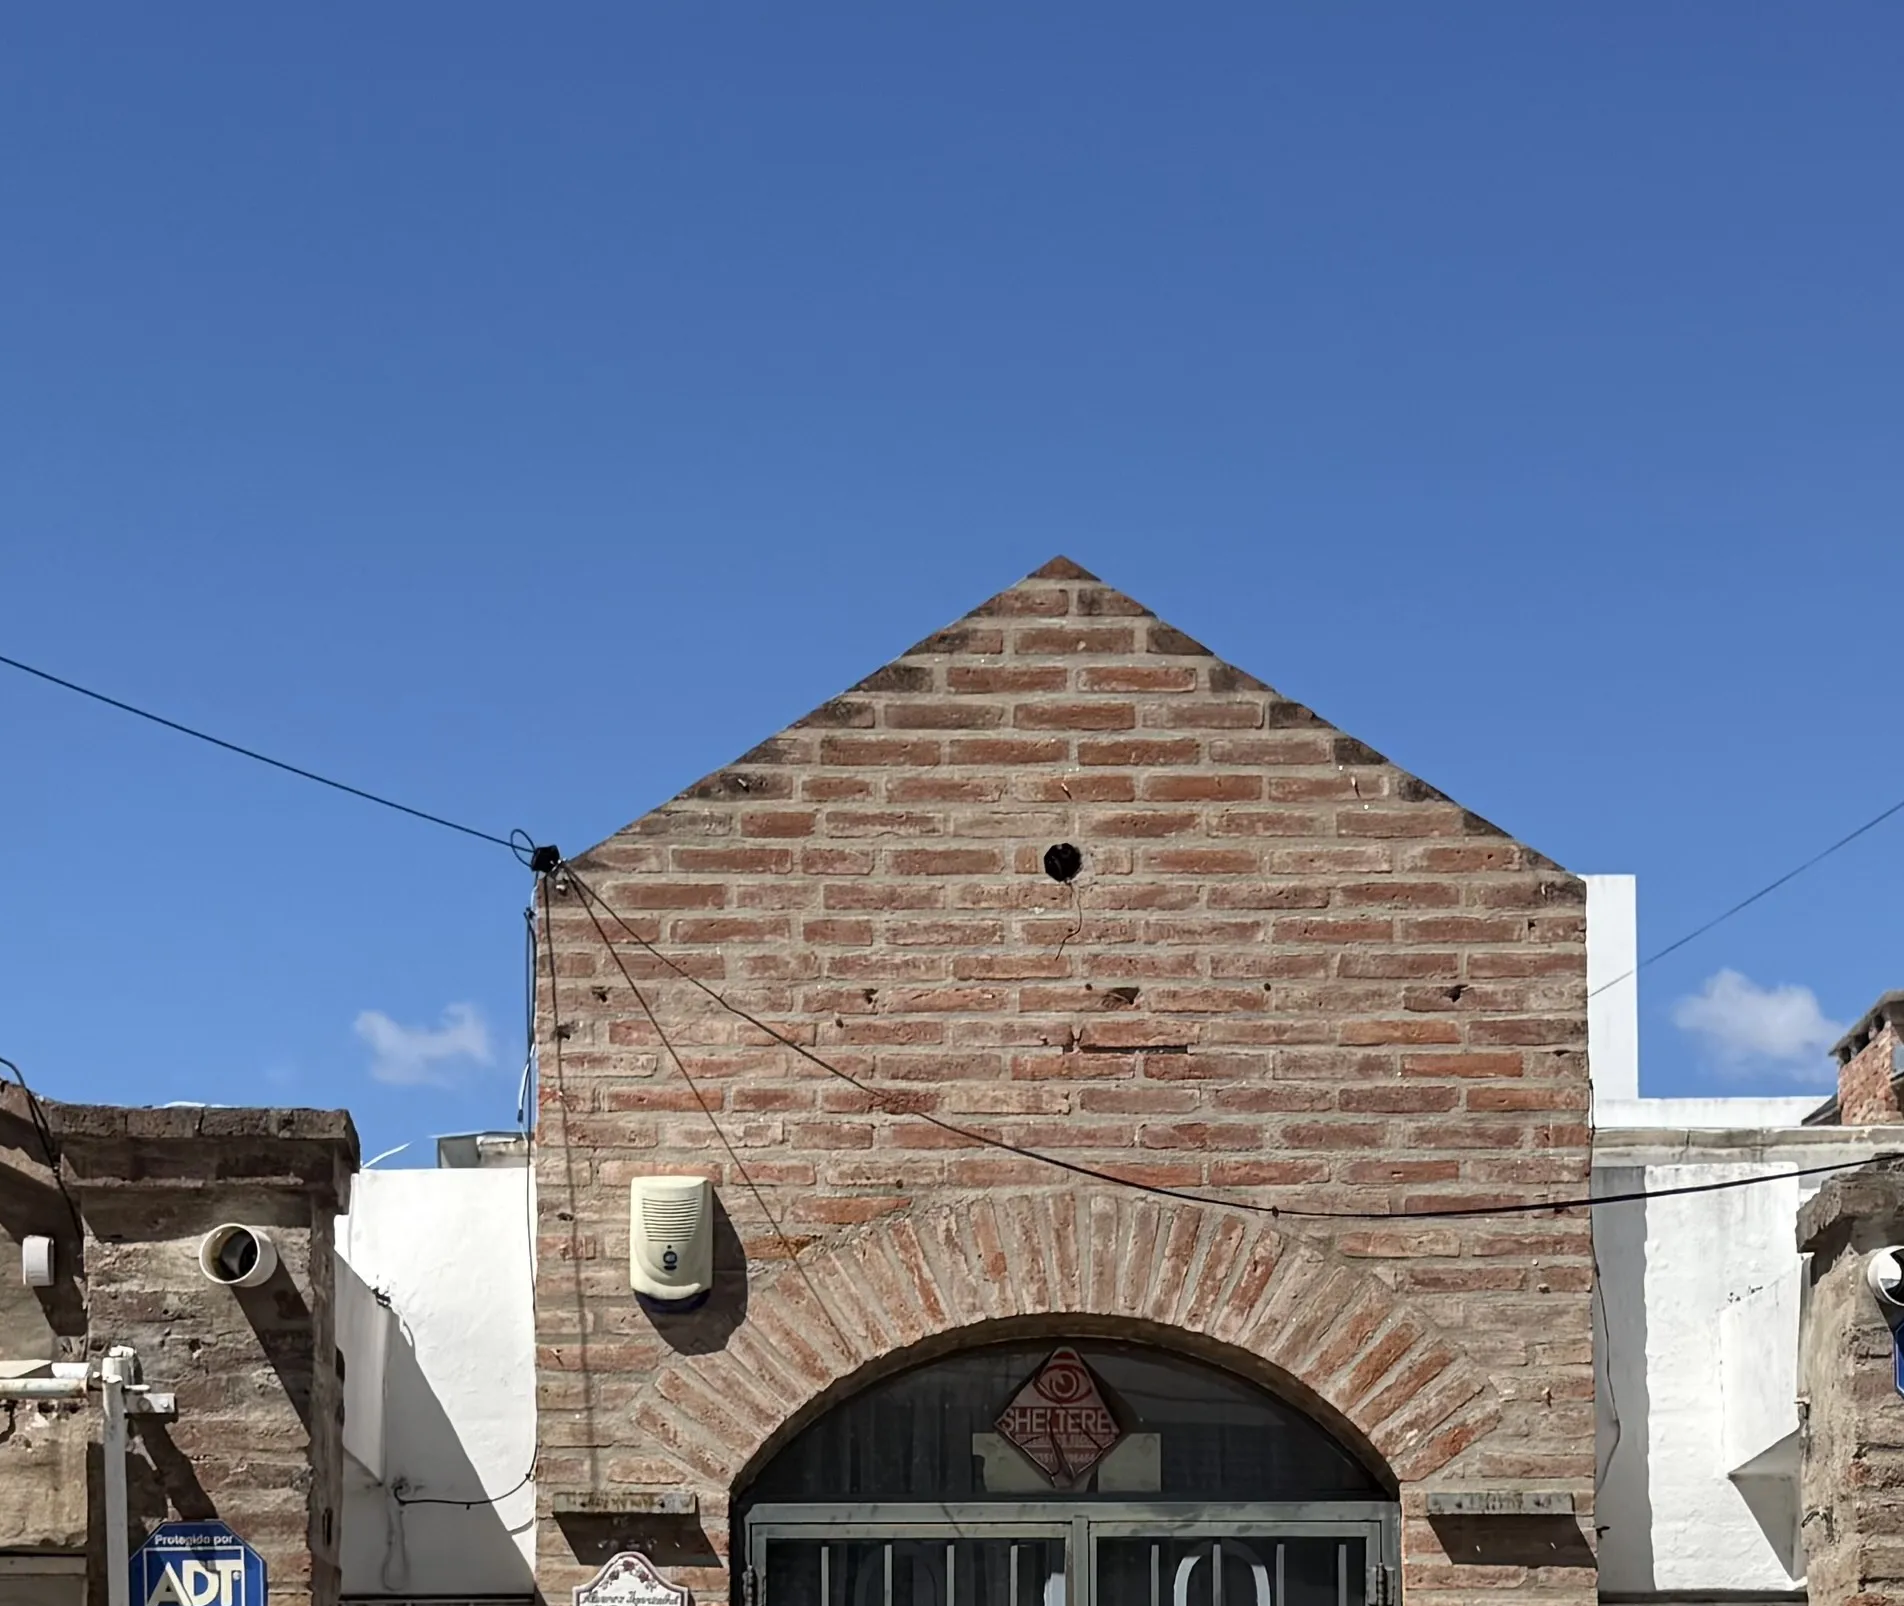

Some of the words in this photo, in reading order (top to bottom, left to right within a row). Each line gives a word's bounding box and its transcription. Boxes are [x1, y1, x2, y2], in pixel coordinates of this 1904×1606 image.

[154, 1535, 211, 1546] Protegido
[213, 1535, 233, 1546] por
[148, 1560, 242, 1606] ADT
